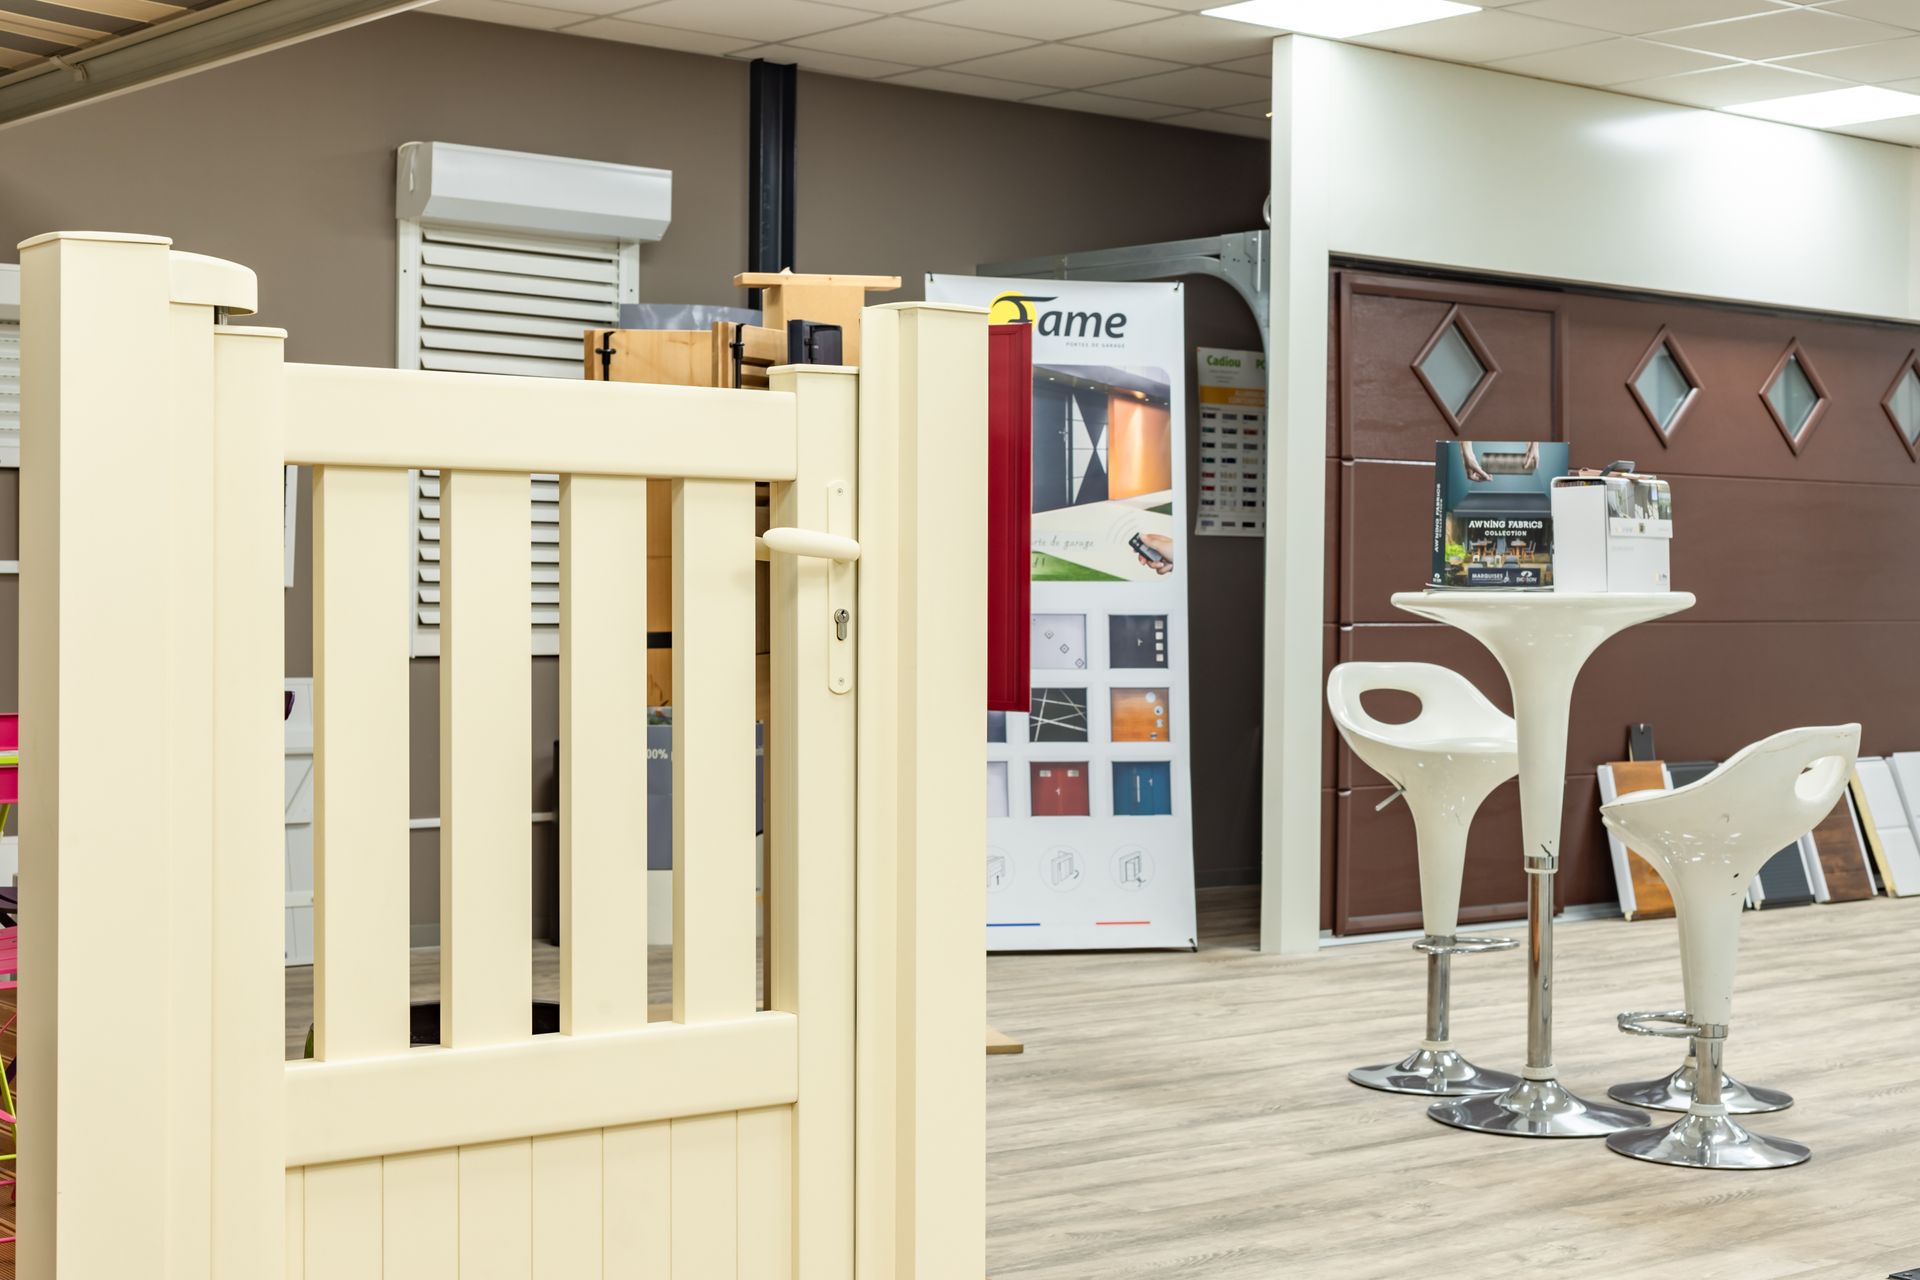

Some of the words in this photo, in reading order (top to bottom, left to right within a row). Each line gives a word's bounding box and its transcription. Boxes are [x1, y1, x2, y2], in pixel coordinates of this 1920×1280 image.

[1206, 354, 1241, 369] Cadiou
[1469, 519, 1505, 529] AWNING
[1508, 520, 1543, 529] FABRICS
[647, 749, 668, 759] 00%
